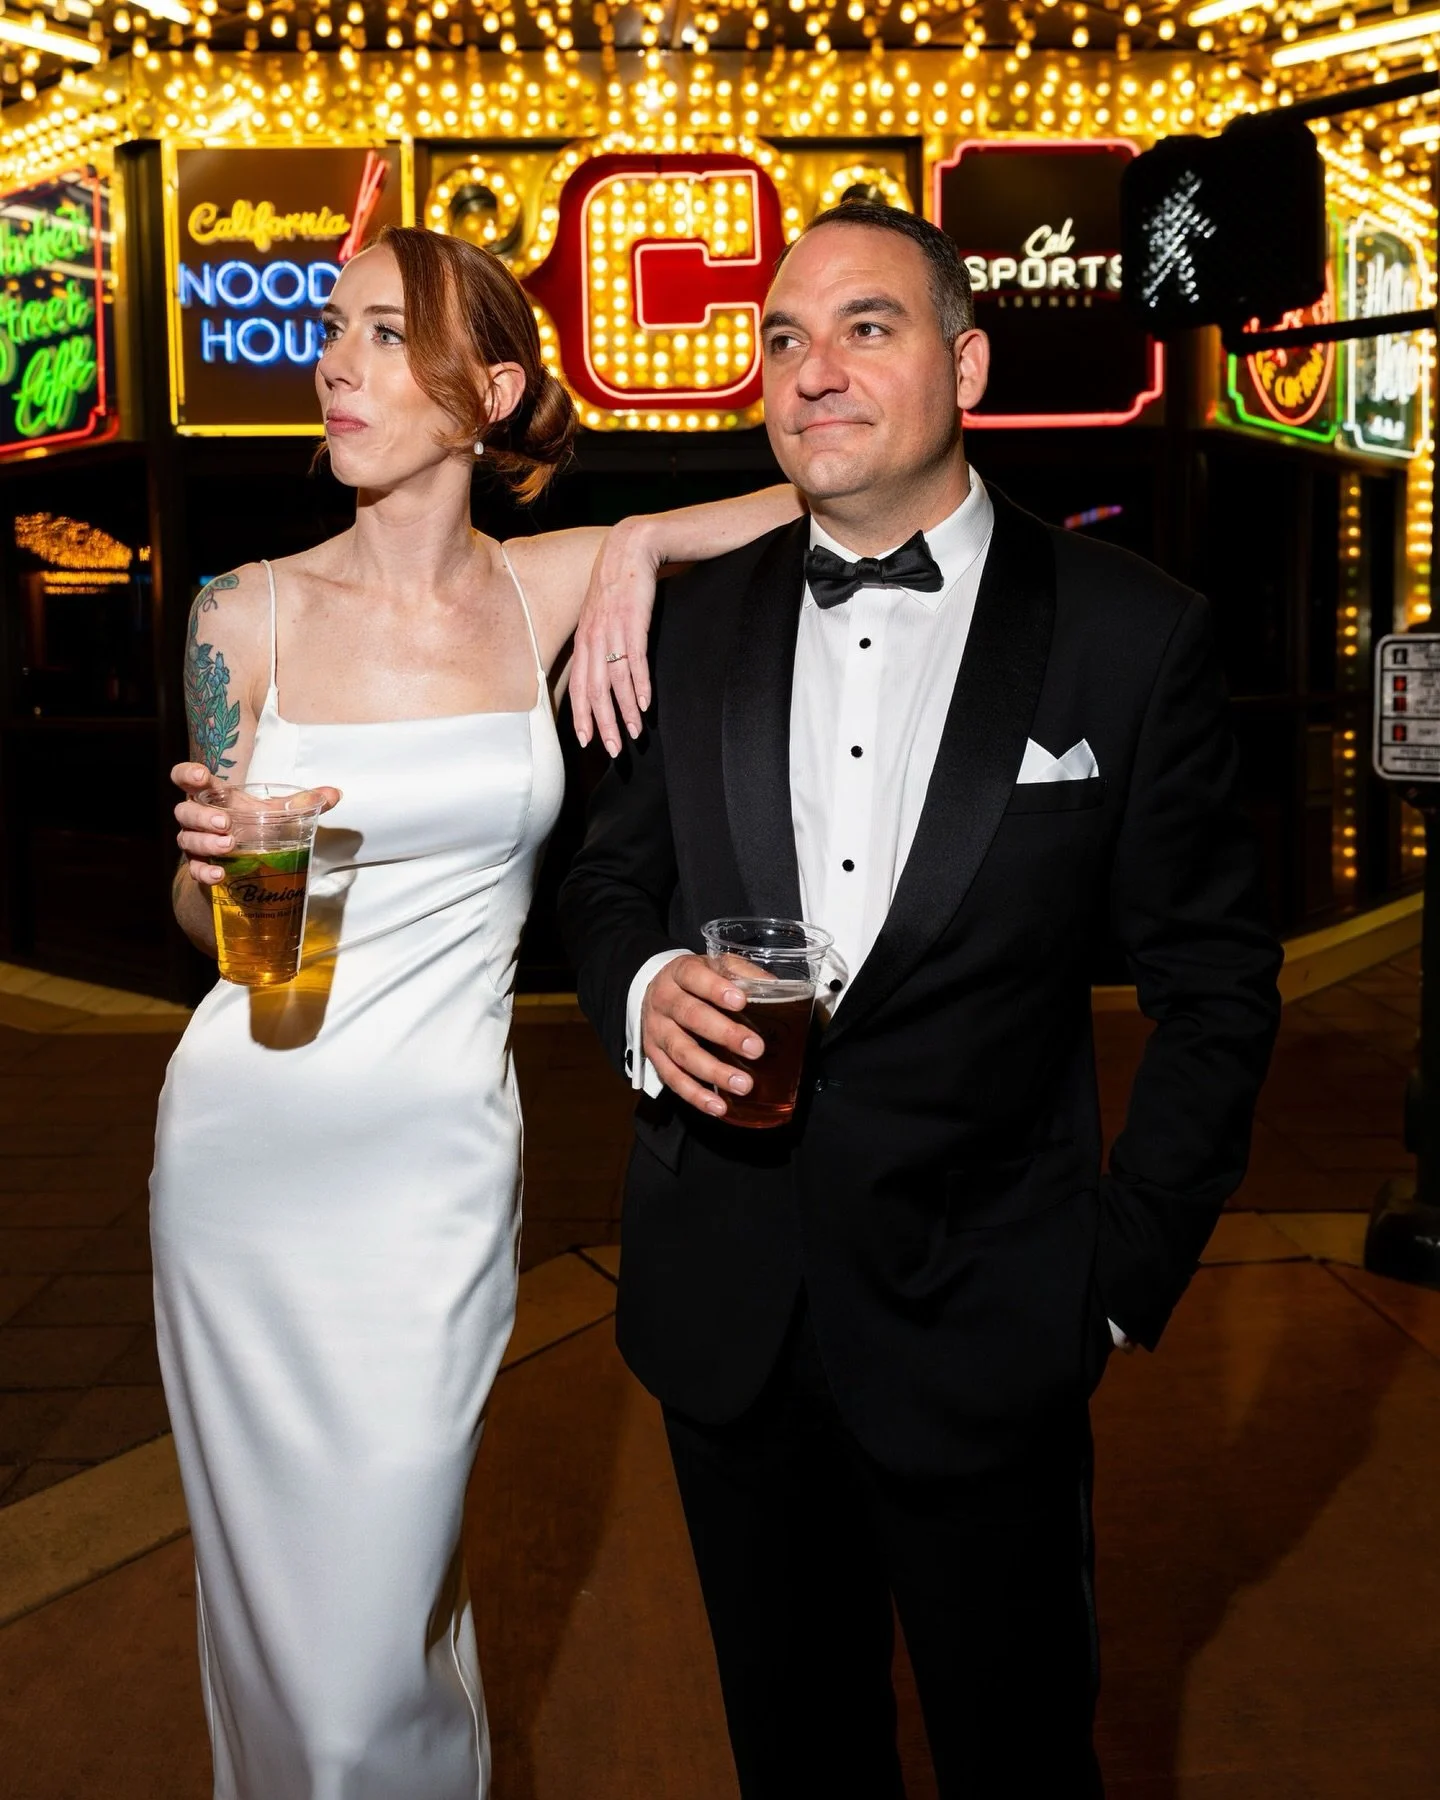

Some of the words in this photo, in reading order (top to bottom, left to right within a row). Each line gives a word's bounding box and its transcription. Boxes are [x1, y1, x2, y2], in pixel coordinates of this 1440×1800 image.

[0, 204, 88, 275] arket
[188, 199, 351, 252] California
[1024, 217, 1075, 259] Cal
[178, 260, 342, 306] NOOD
[580, 168, 763, 400] C
[0, 279, 92, 344] treet
[202, 317, 326, 362] HOU
